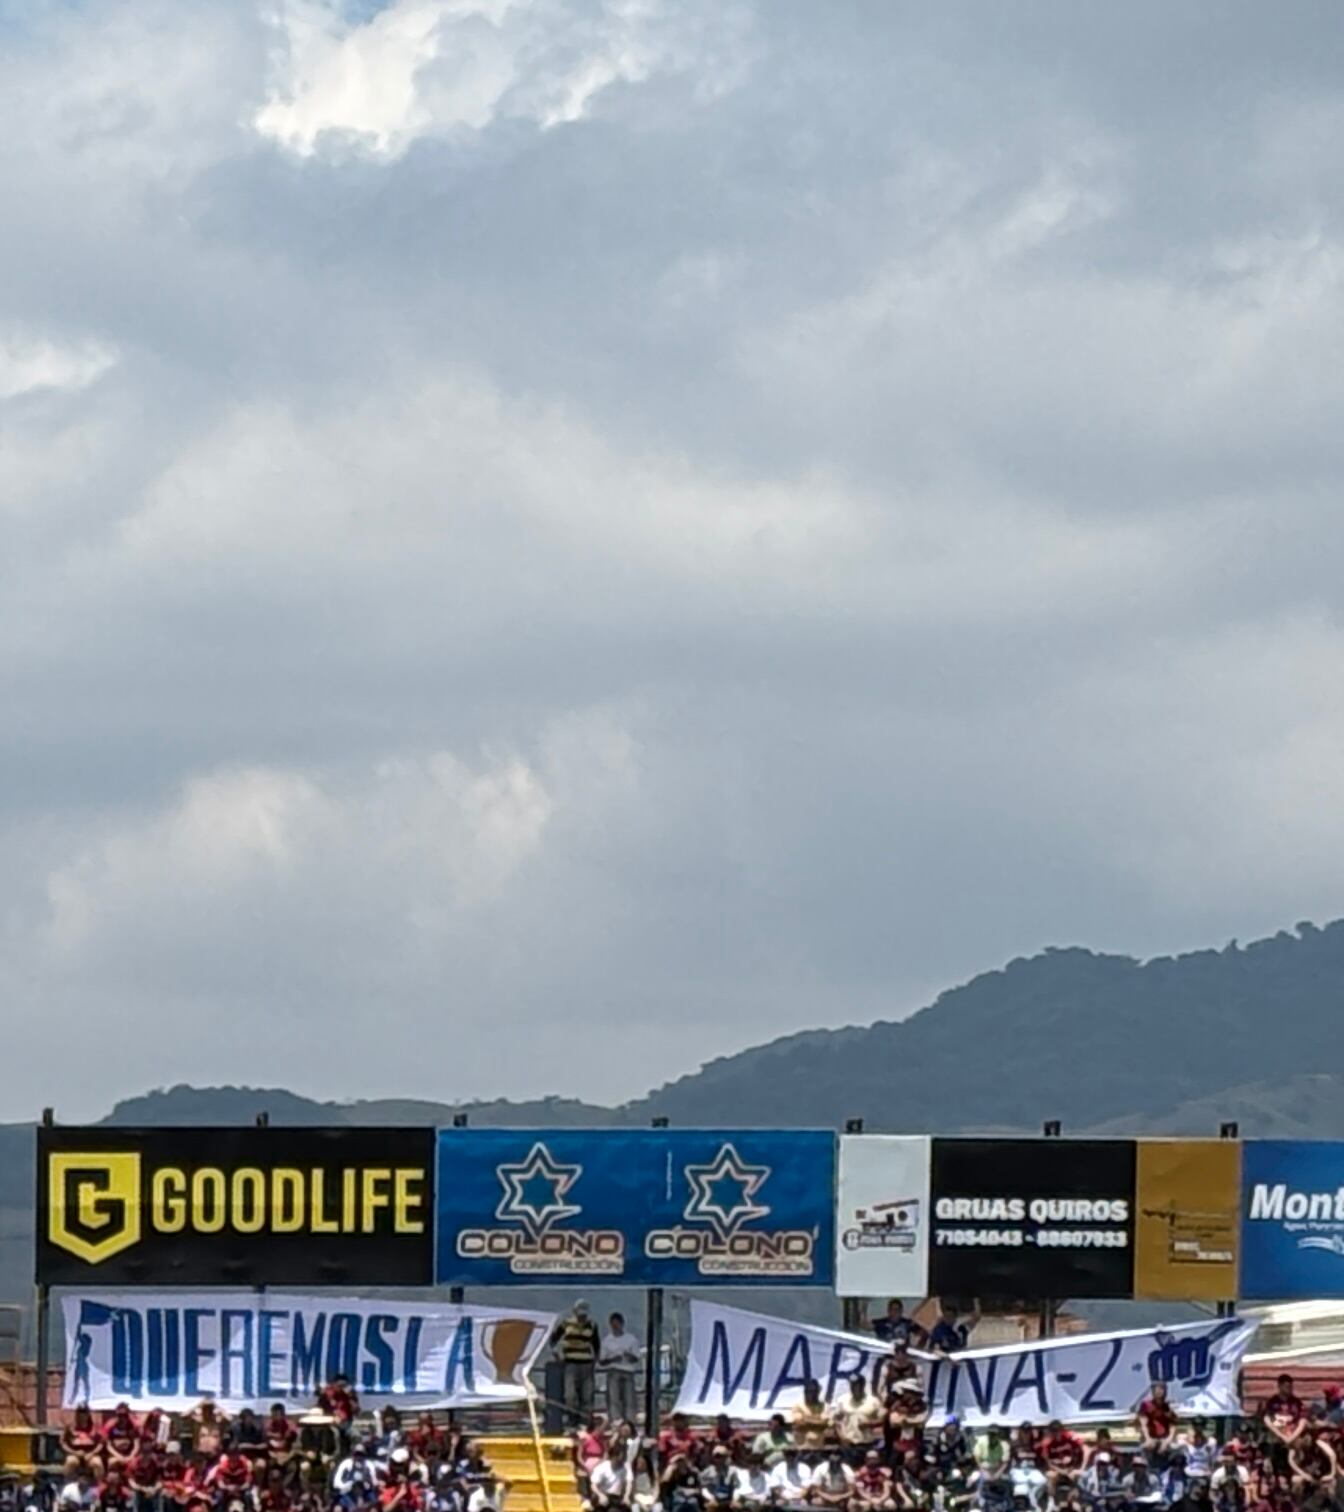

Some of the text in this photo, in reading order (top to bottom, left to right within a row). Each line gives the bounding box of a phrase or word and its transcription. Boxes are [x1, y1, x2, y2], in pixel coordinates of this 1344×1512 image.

[152, 1167, 425, 1235] GOODLIFE
[935, 1198, 1128, 1224] GRUAS QUIROS
[458, 1230, 623, 1258] COLONO
[647, 1230, 811, 1258] COLONO
